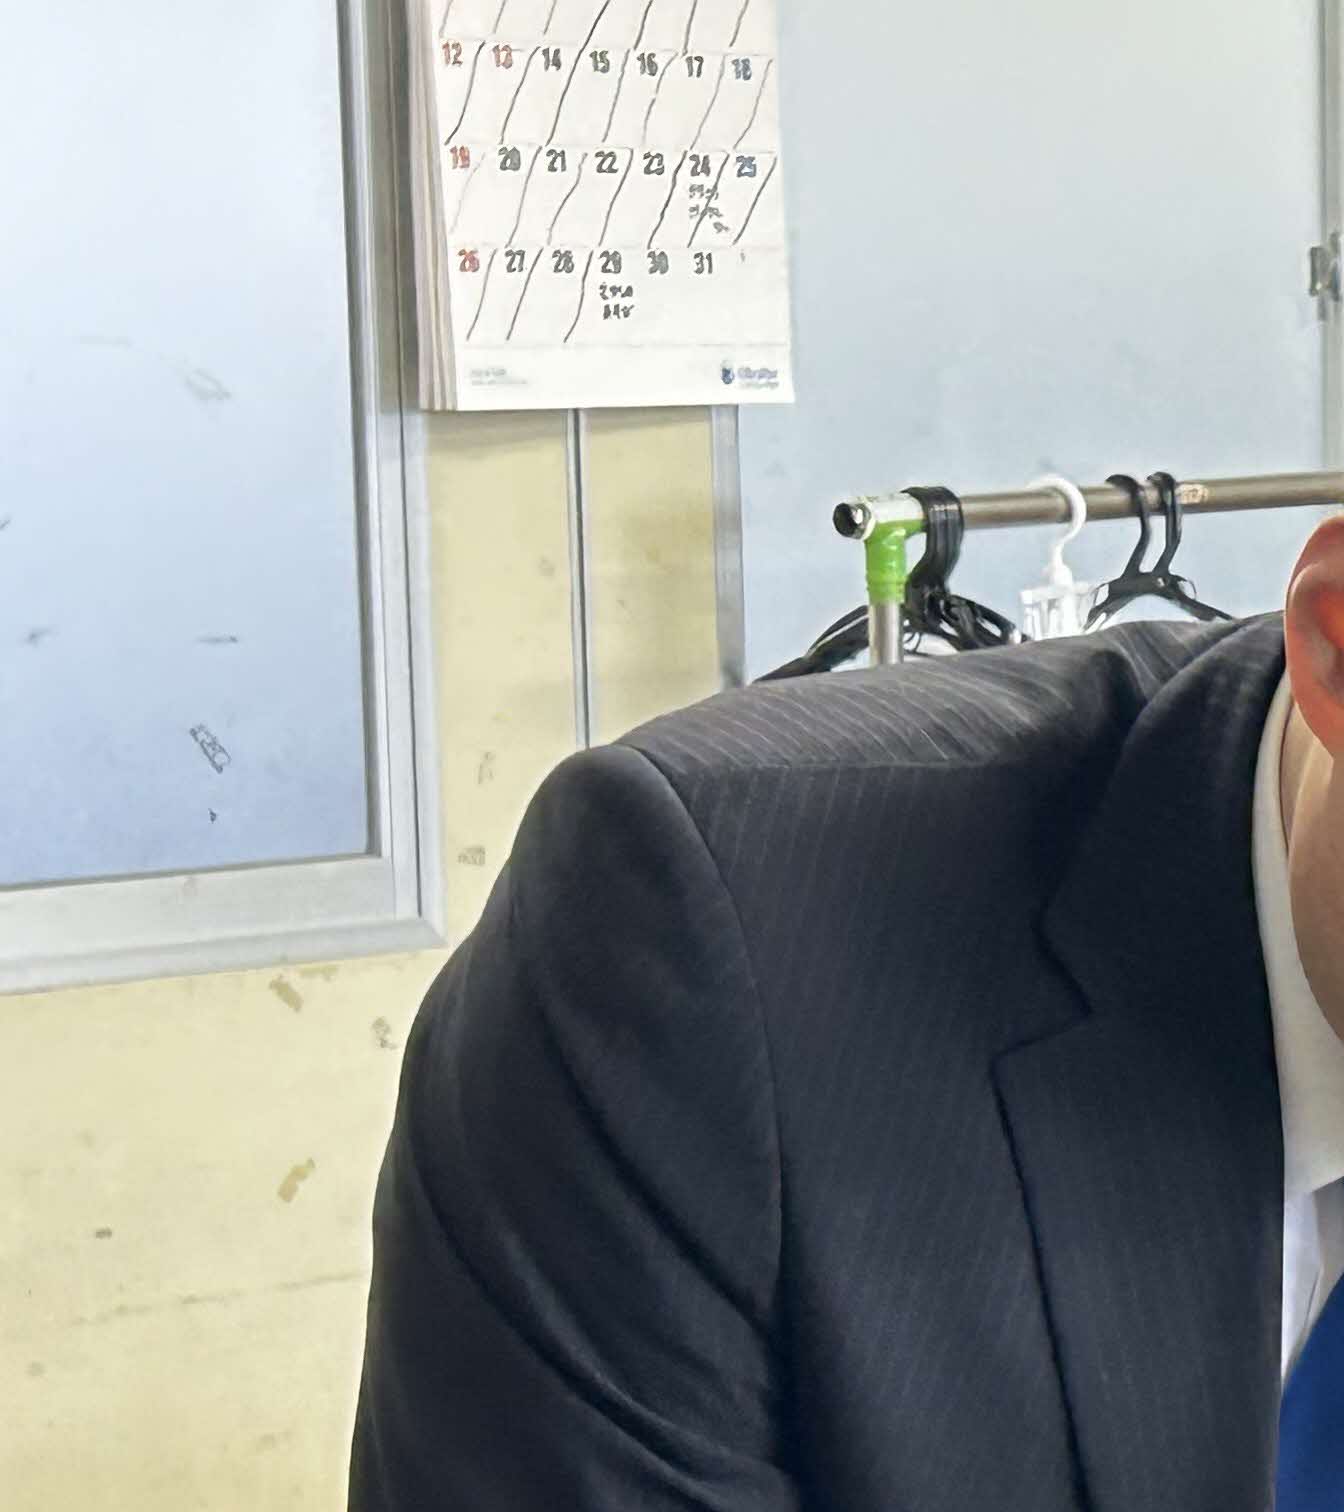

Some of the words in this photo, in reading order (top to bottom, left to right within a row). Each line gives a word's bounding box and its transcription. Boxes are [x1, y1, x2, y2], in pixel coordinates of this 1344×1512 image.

[442, 42, 463, 65] 12
[492, 45, 513, 68] 13
[542, 48, 561, 70] 14
[590, 51, 610, 73] 15
[637, 53, 657, 76] 16
[686, 56, 704, 77] 17
[732, 58, 751, 80] 18
[450, 147, 470, 168] 19
[499, 147, 521, 171] 20
[547, 150, 567, 172] 21
[595, 151, 618, 173] 22
[644, 153, 664, 175] 23
[690, 155, 711, 176] 24
[737, 156, 756, 177] 25
[458, 250, 479, 272] 26
[506, 251, 525, 272] 27
[552, 251, 574, 273] 28
[600, 252, 621, 273] 29
[648, 253, 668, 274] 30
[694, 254, 712, 274] 31
